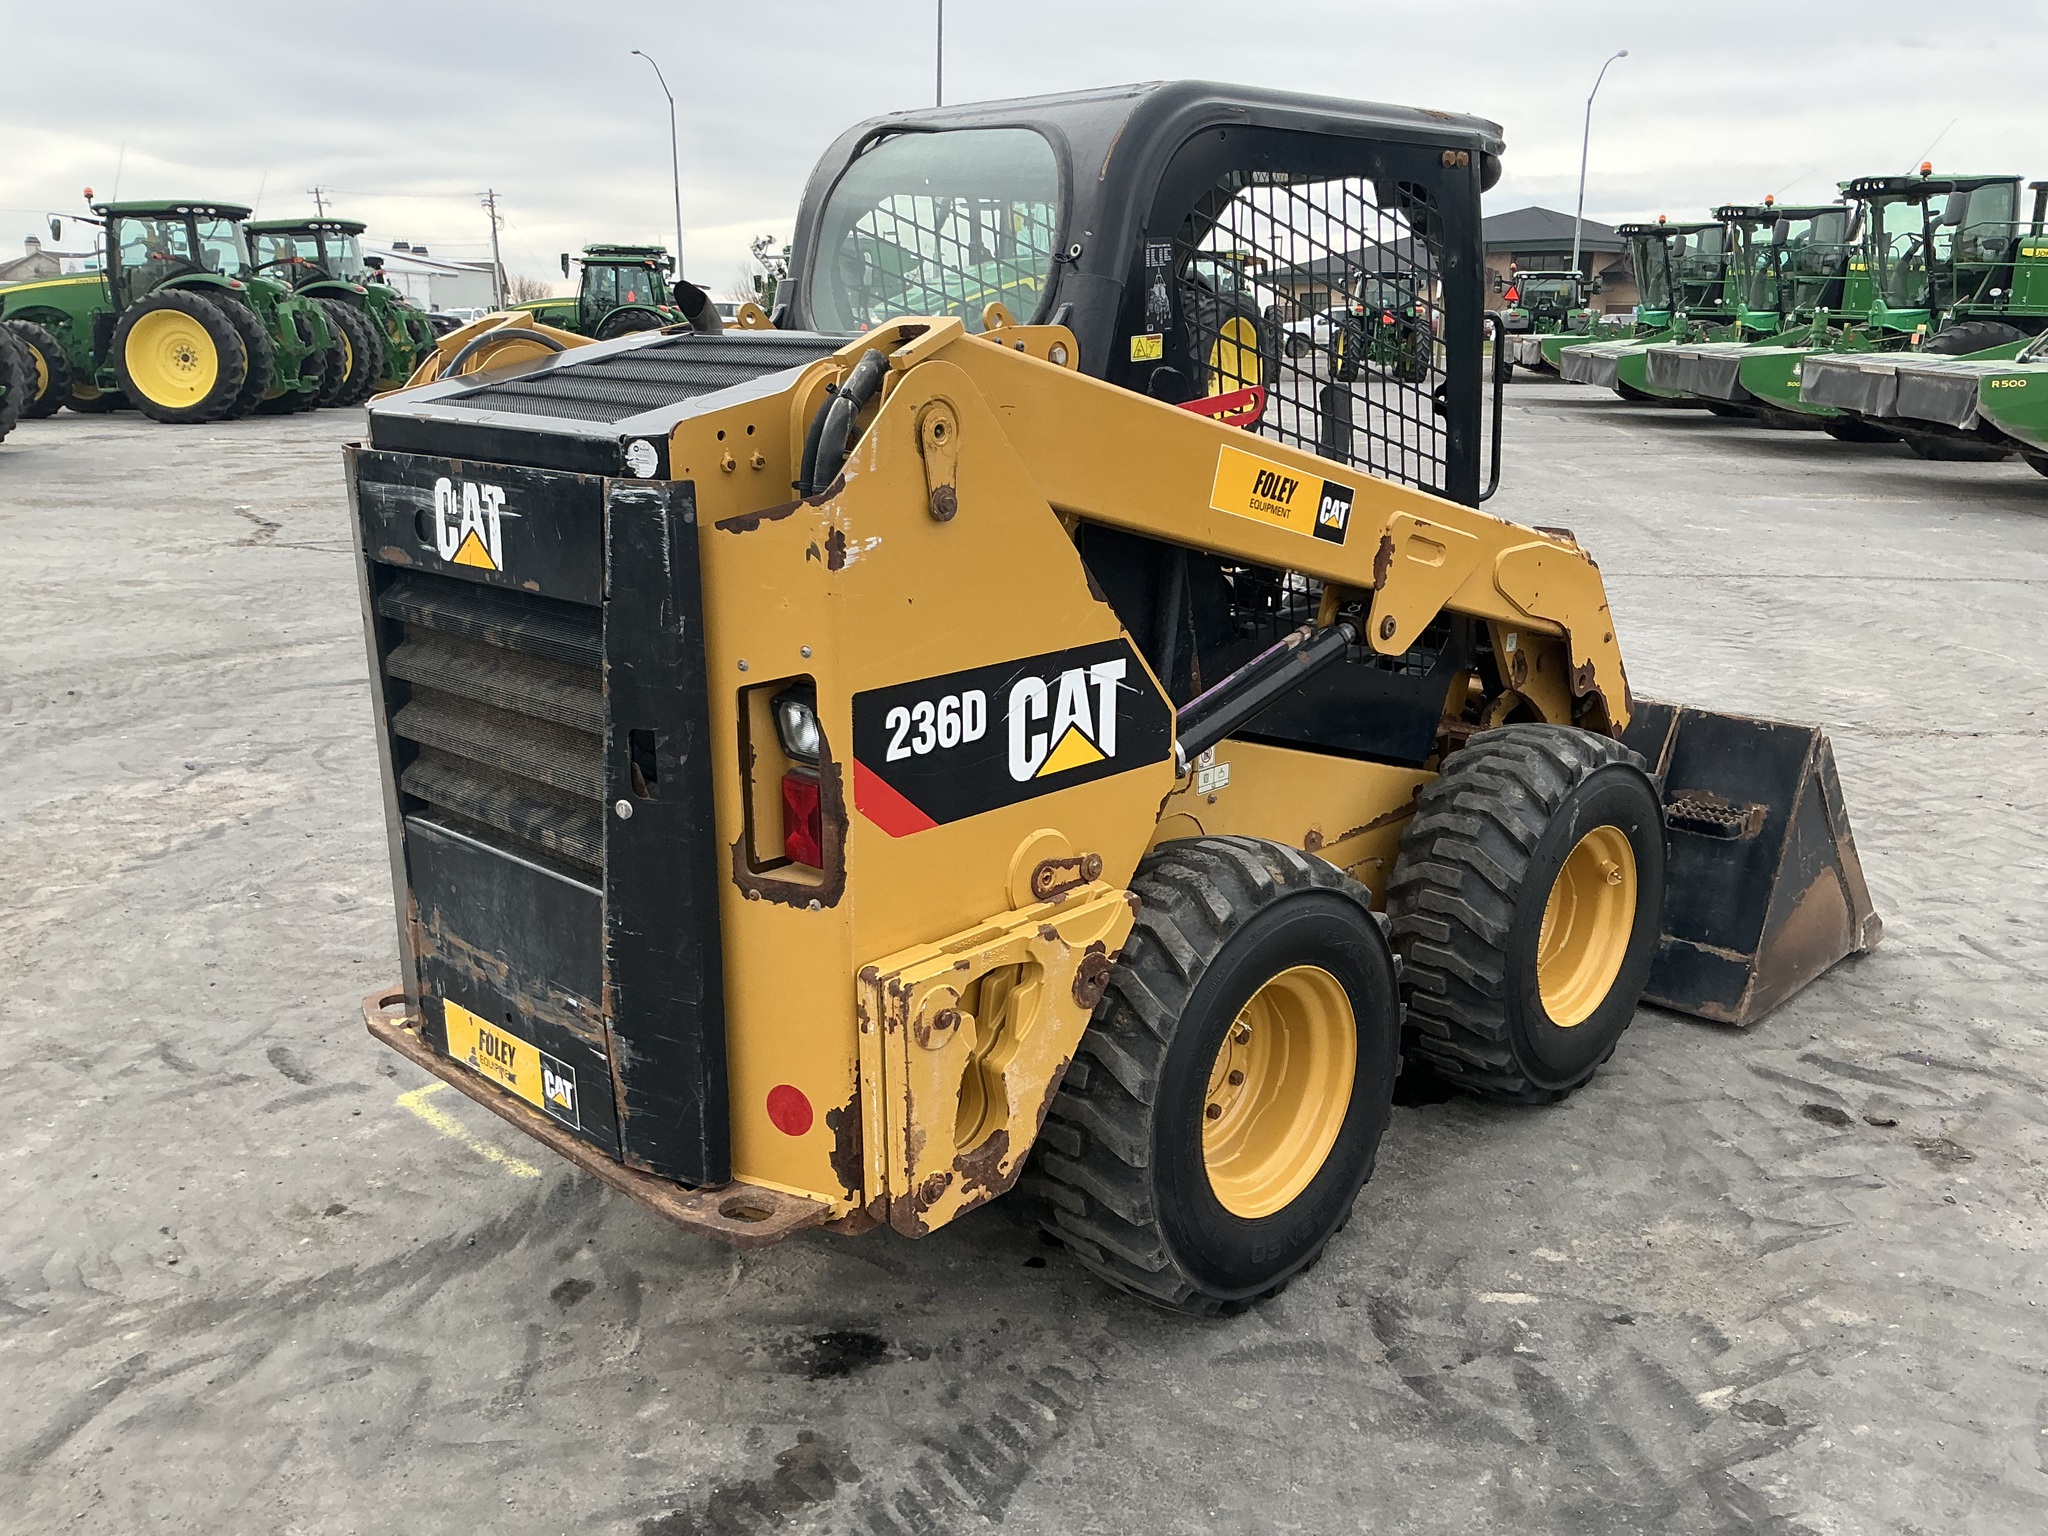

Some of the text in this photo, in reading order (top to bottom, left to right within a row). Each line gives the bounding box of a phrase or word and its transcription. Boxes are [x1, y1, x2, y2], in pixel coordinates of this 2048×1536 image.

[1252, 469, 1299, 505] FOLEY
[435, 477, 506, 572] CAT
[1249, 498, 1292, 519] EQUIPMENT
[1319, 496, 1349, 530] CAT
[885, 658, 1127, 782] 236D CAT
[479, 1028, 517, 1069] FOLEY
[479, 1054, 518, 1085] EQUIPME
[544, 1069, 573, 1111] CAT
